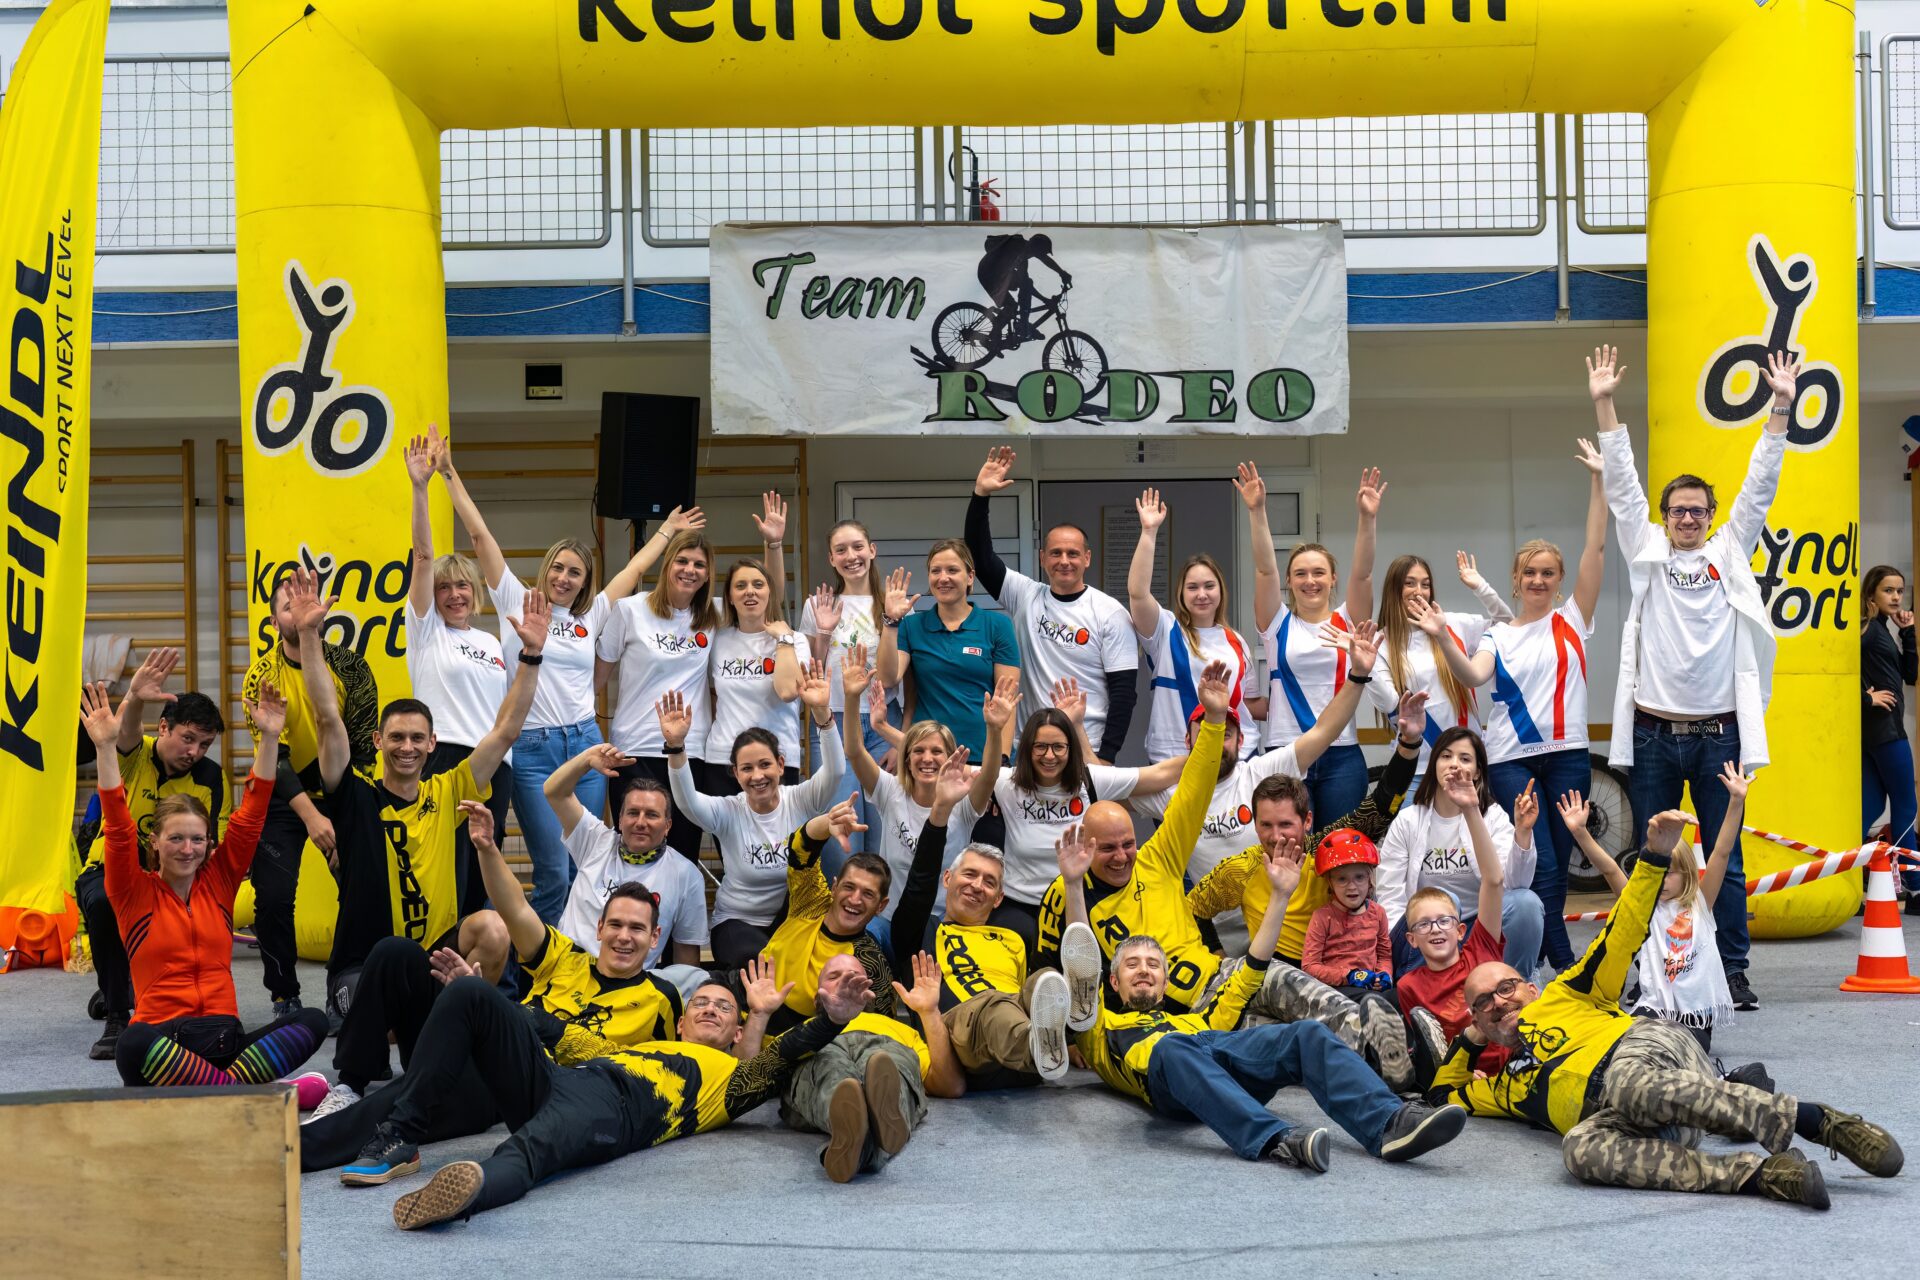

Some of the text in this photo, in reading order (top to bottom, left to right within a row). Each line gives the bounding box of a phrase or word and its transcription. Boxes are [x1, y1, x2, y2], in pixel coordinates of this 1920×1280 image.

[56, 208, 73, 299] LEVEL
[752, 251, 926, 321] Team
[56, 305, 73, 390] NEXT
[922, 367, 1316, 424] RODEO
[0, 231, 60, 772] KEINDL
[252, 546, 414, 604] keind
[1750, 521, 1858, 577] indl
[257, 607, 408, 658] sort
[547, 621, 588, 638] aKaO
[1762, 579, 1852, 631] ort
[751, 843, 790, 864] KaKa
[1420, 848, 1469, 871] KaKa
